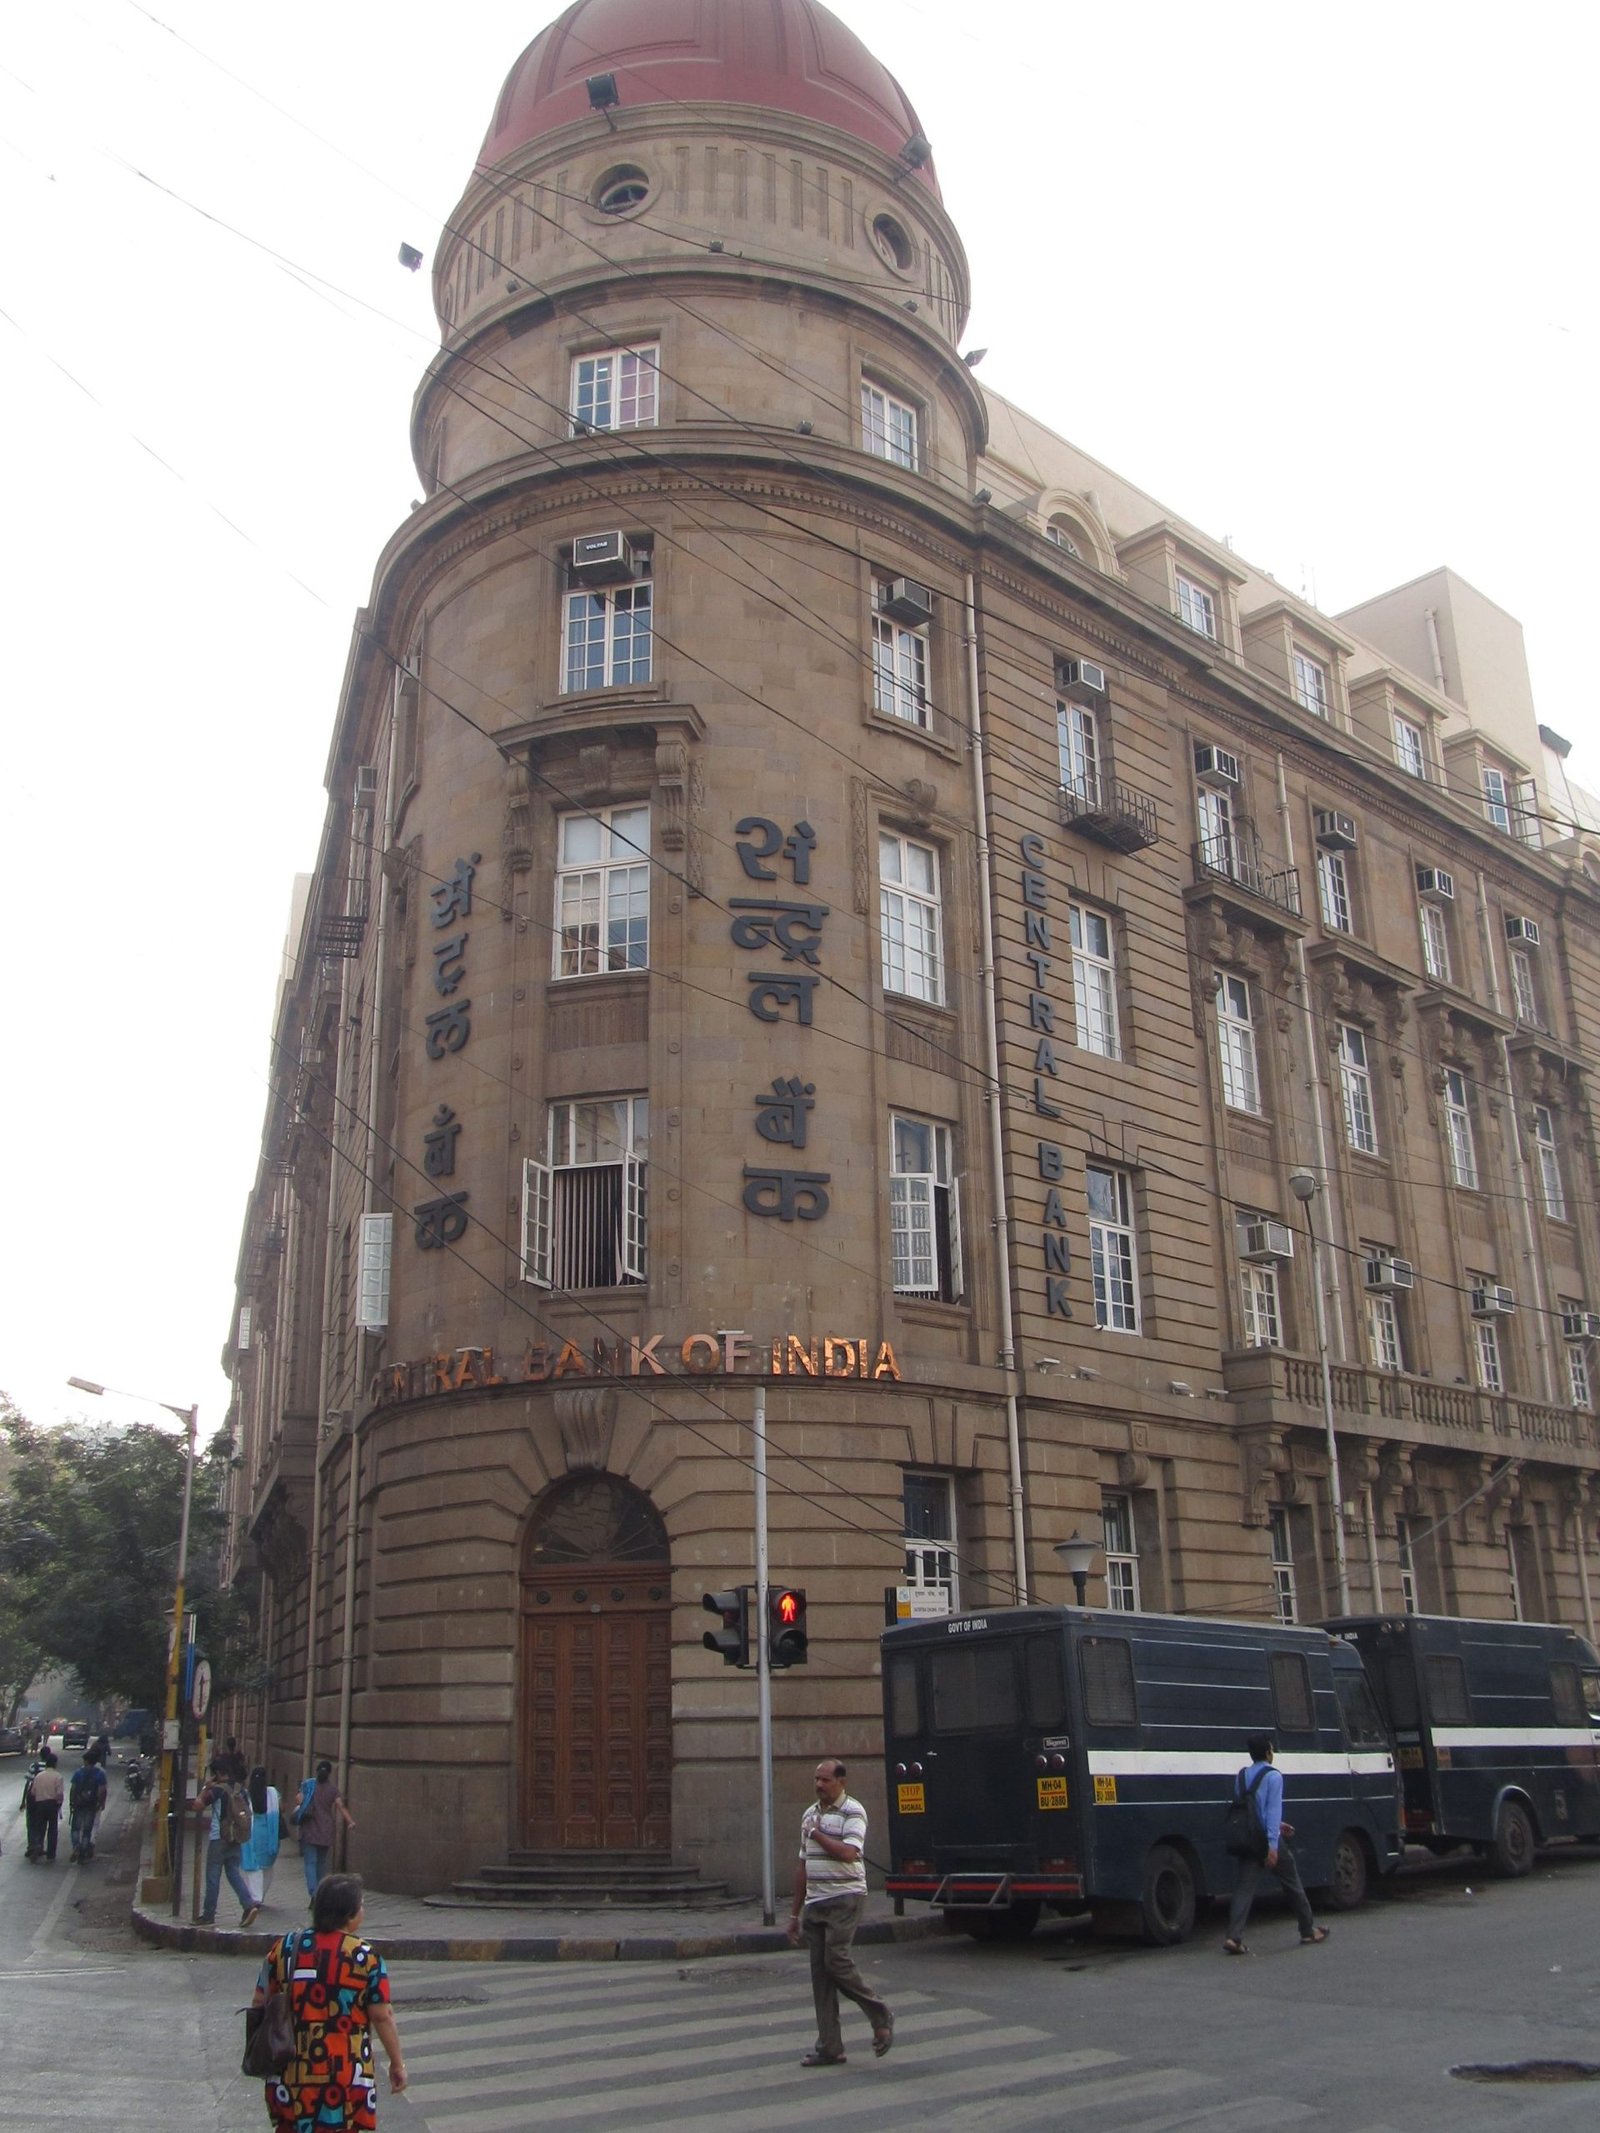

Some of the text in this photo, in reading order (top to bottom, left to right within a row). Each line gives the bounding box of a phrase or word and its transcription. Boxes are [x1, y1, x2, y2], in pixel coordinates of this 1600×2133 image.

[1020, 834, 1072, 1318] CENTRAL BANK
[743, 1076, 831, 1222] बैंक
[523, 1334, 666, 1382] BANK
[681, 1333, 754, 1375] OF
[770, 1334, 902, 1382] INDIA
[948, 1618, 988, 1634] GOVT OF INDIA
[900, 1785, 921, 1797] STOP
